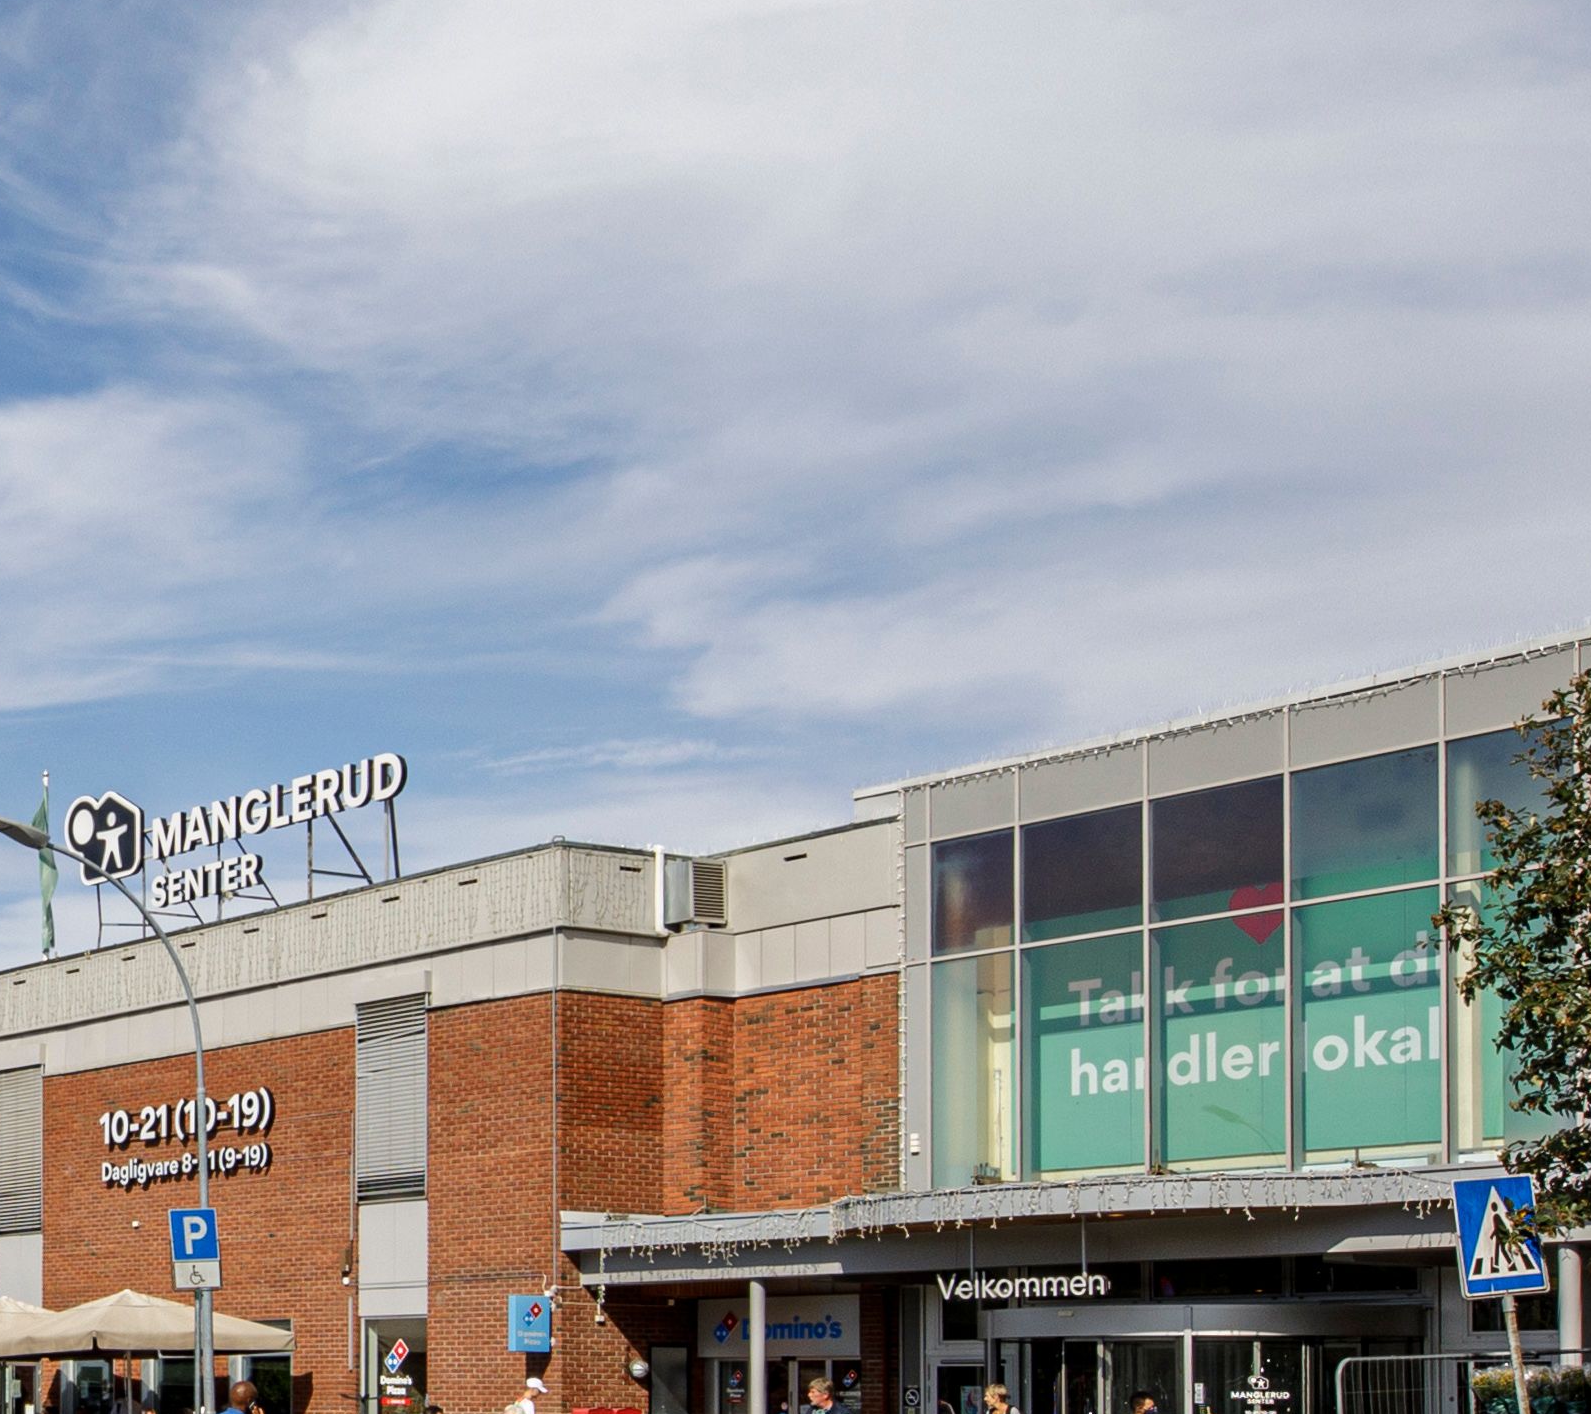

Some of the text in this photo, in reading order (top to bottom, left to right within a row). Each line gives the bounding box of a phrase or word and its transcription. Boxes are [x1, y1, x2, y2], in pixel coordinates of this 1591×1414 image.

[152, 752, 405, 859] MANGLERUD
[151, 853, 260, 908] SENTER
[1312, 946, 1370, 996] at
[1390, 930, 1441, 986] d
[99, 1087, 271, 1145] 10-21 (10-19)
[102, 1143, 268, 1185] Dagligvare 8-1 (9-19)
[183, 1216, 208, 1254] P
[937, 1271, 1105, 1301] Velkommen
[1230, 1391, 1290, 1399] MANGLERUD
